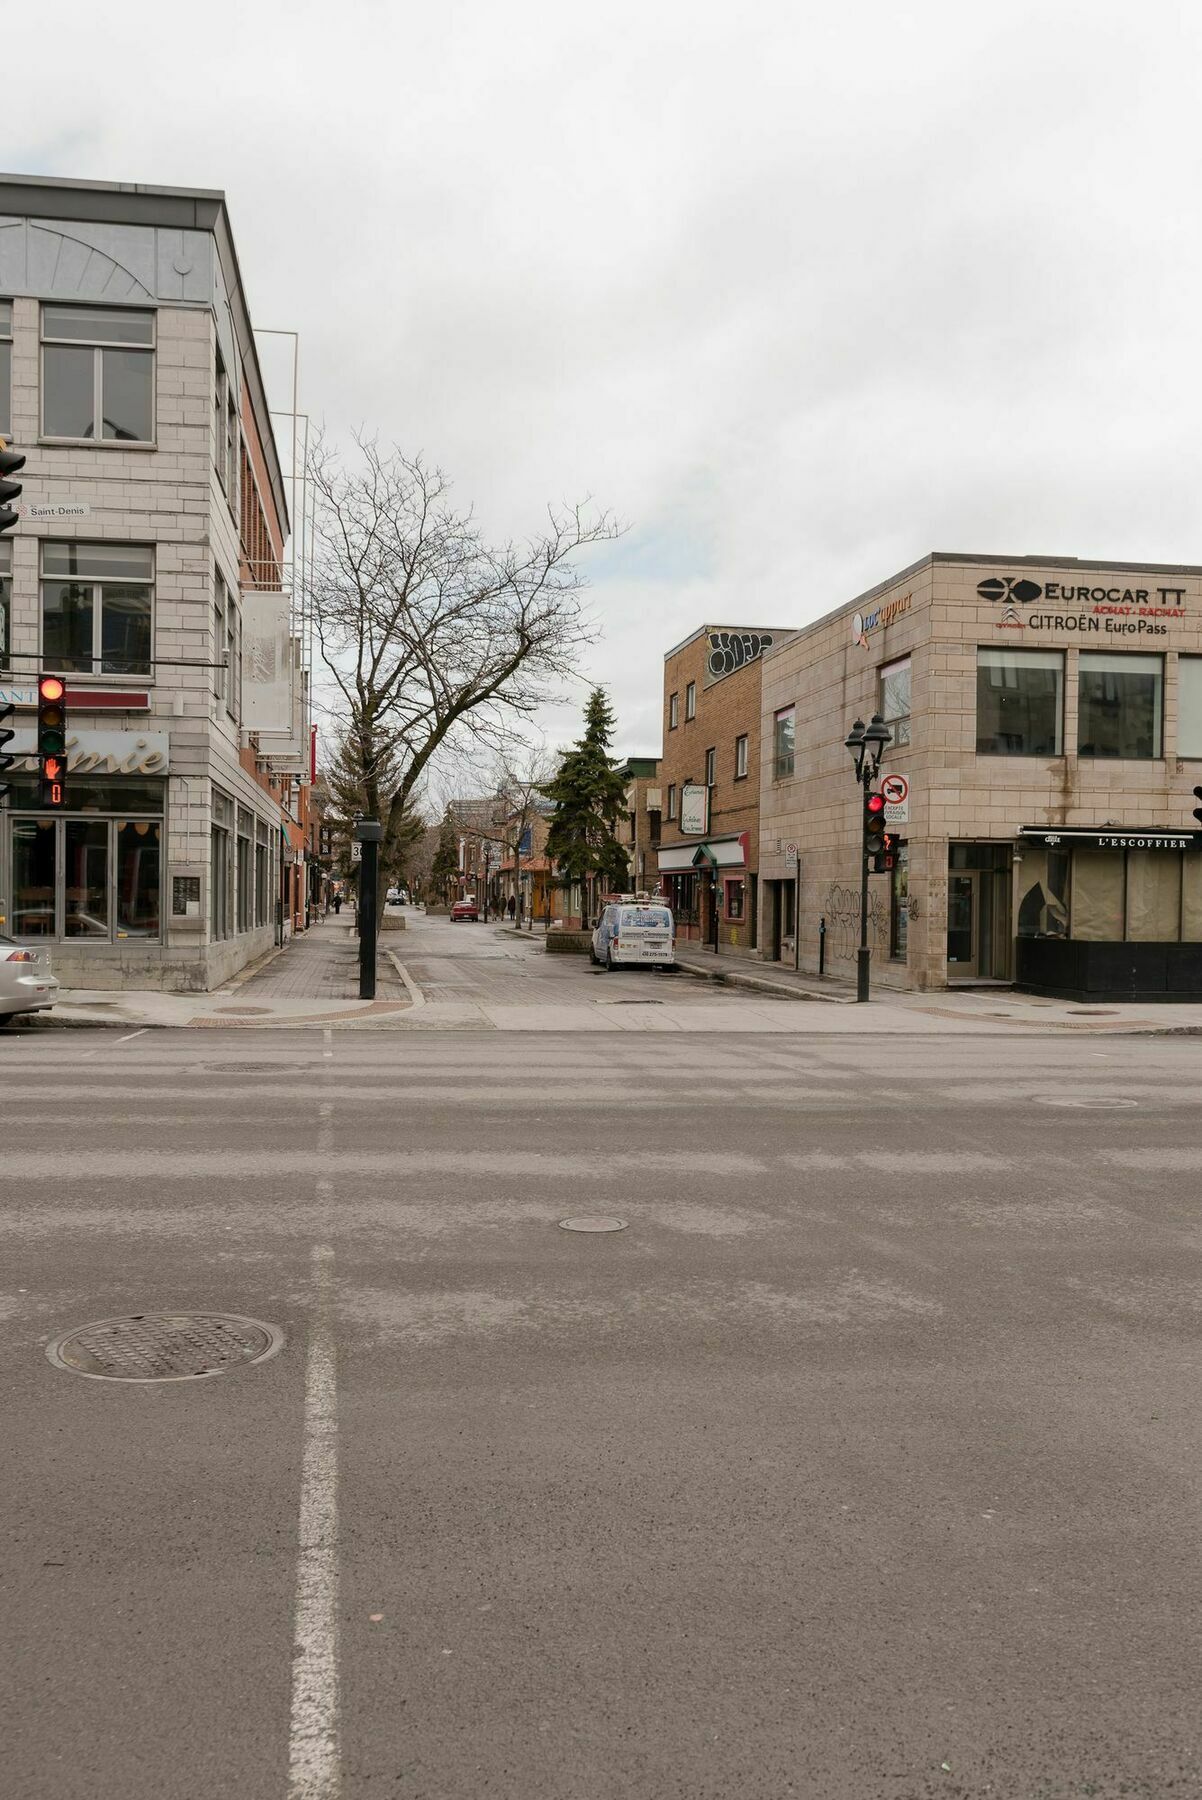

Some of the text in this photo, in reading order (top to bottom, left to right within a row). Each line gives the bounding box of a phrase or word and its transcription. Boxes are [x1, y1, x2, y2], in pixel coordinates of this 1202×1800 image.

[31, 506, 84, 516] Saint-Denis
[1045, 583, 1186, 605] EUROCAR TT
[1092, 605, 1186, 618] ACHAT RACHAT
[1029, 613, 1099, 632] CITROËN
[1099, 838, 1187, 848] L'ESCOFFIER
